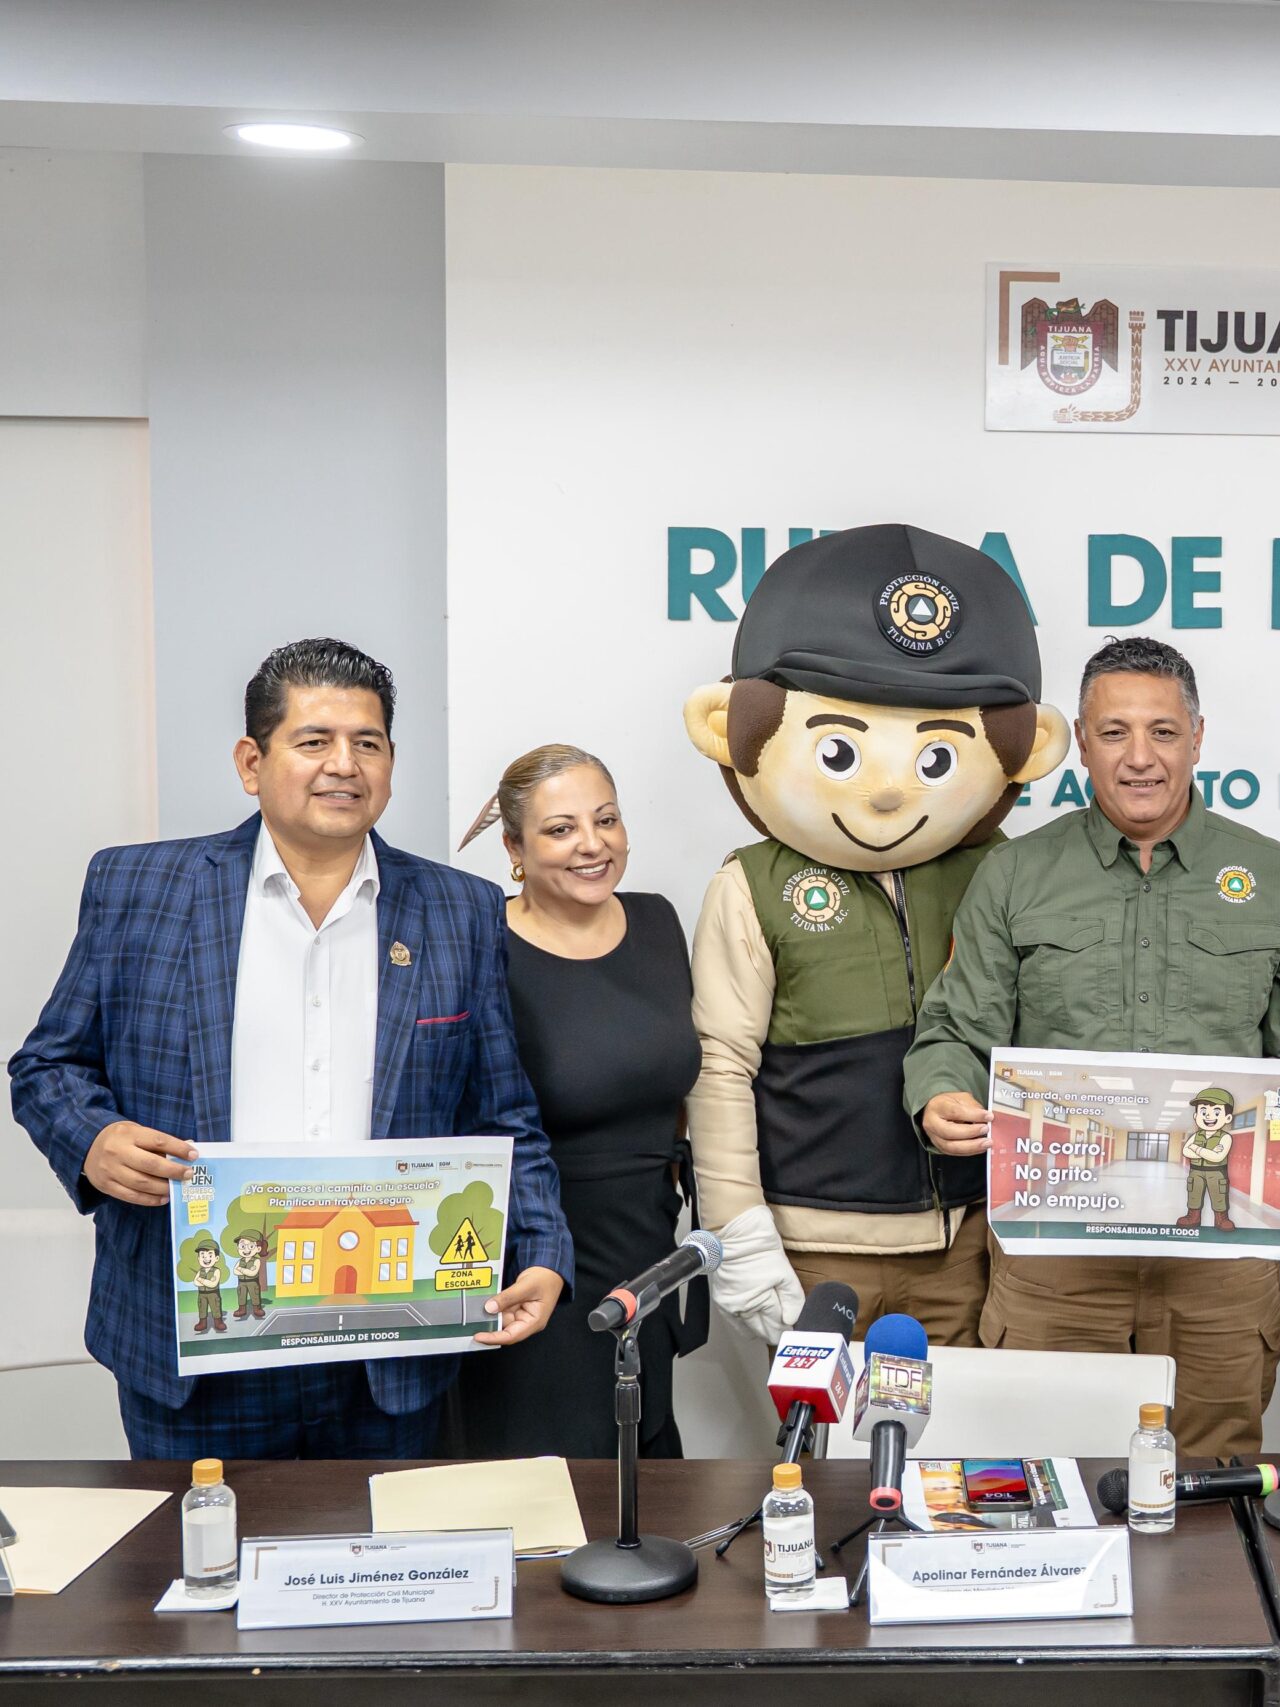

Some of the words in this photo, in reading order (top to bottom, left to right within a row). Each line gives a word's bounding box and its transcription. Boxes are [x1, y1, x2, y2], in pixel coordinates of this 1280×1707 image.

[1048, 325, 1092, 333] TIJUANA
[1165, 358, 1202, 372] XXV
[1163, 376, 1212, 386] 2024
[1086, 533, 1223, 630] DE
[880, 574, 940, 606] PROTECCIÓN
[940, 585, 960, 612] CIVIL
[887, 626, 933, 650] TIJUANA
[830, 872, 850, 896] CIVIL
[1011, 1090, 1061, 1100] recuerda,
[1081, 1094, 1149, 1105] emergencias
[1044, 1106, 1050, 1114] y
[1066, 1107, 1104, 1115] receso:
[1016, 1138, 1043, 1154] No
[1049, 1142, 1105, 1156] corro.
[1015, 1165, 1042, 1180] No
[1048, 1166, 1097, 1185] grito.
[246, 1184, 263, 1194] ¿Ya
[267, 1185, 312, 1193] conoces
[315, 1184, 324, 1193] el
[327, 1183, 372, 1193] caminito
[385, 1183, 394, 1191] tu
[396, 1181, 440, 1191] escuela?
[269, 1198, 315, 1207] Planifica
[334, 1197, 376, 1208] trayecto
[379, 1197, 414, 1206] seguro.
[1014, 1191, 1040, 1207] No
[1046, 1193, 1125, 1211] empujo.
[1086, 1226, 1158, 1235] RESPONSABILIDAD
[1172, 1228, 1200, 1236] TODOS
[451, 1270, 473, 1278] ZONA
[445, 1279, 481, 1288] ESCOLAR
[281, 1334, 356, 1346] RESPONSABILIDAD
[358, 1333, 368, 1341] DE
[371, 1332, 400, 1340] TODOS
[783, 1346, 830, 1358] Entérate
[882, 1365, 921, 1389] TDF
[777, 1539, 813, 1552] TIJUANA
[284, 1574, 316, 1586] José
[320, 1573, 345, 1584] Luis
[349, 1570, 404, 1583] Jiménez
[408, 1567, 469, 1581] González
[912, 1570, 967, 1583] Apolinar
[971, 1567, 1037, 1579] Fernández
[402, 1589, 435, 1597] Municipal
[344, 1598, 390, 1607] Ayuntamiento
[402, 1596, 425, 1604] Tijuana
